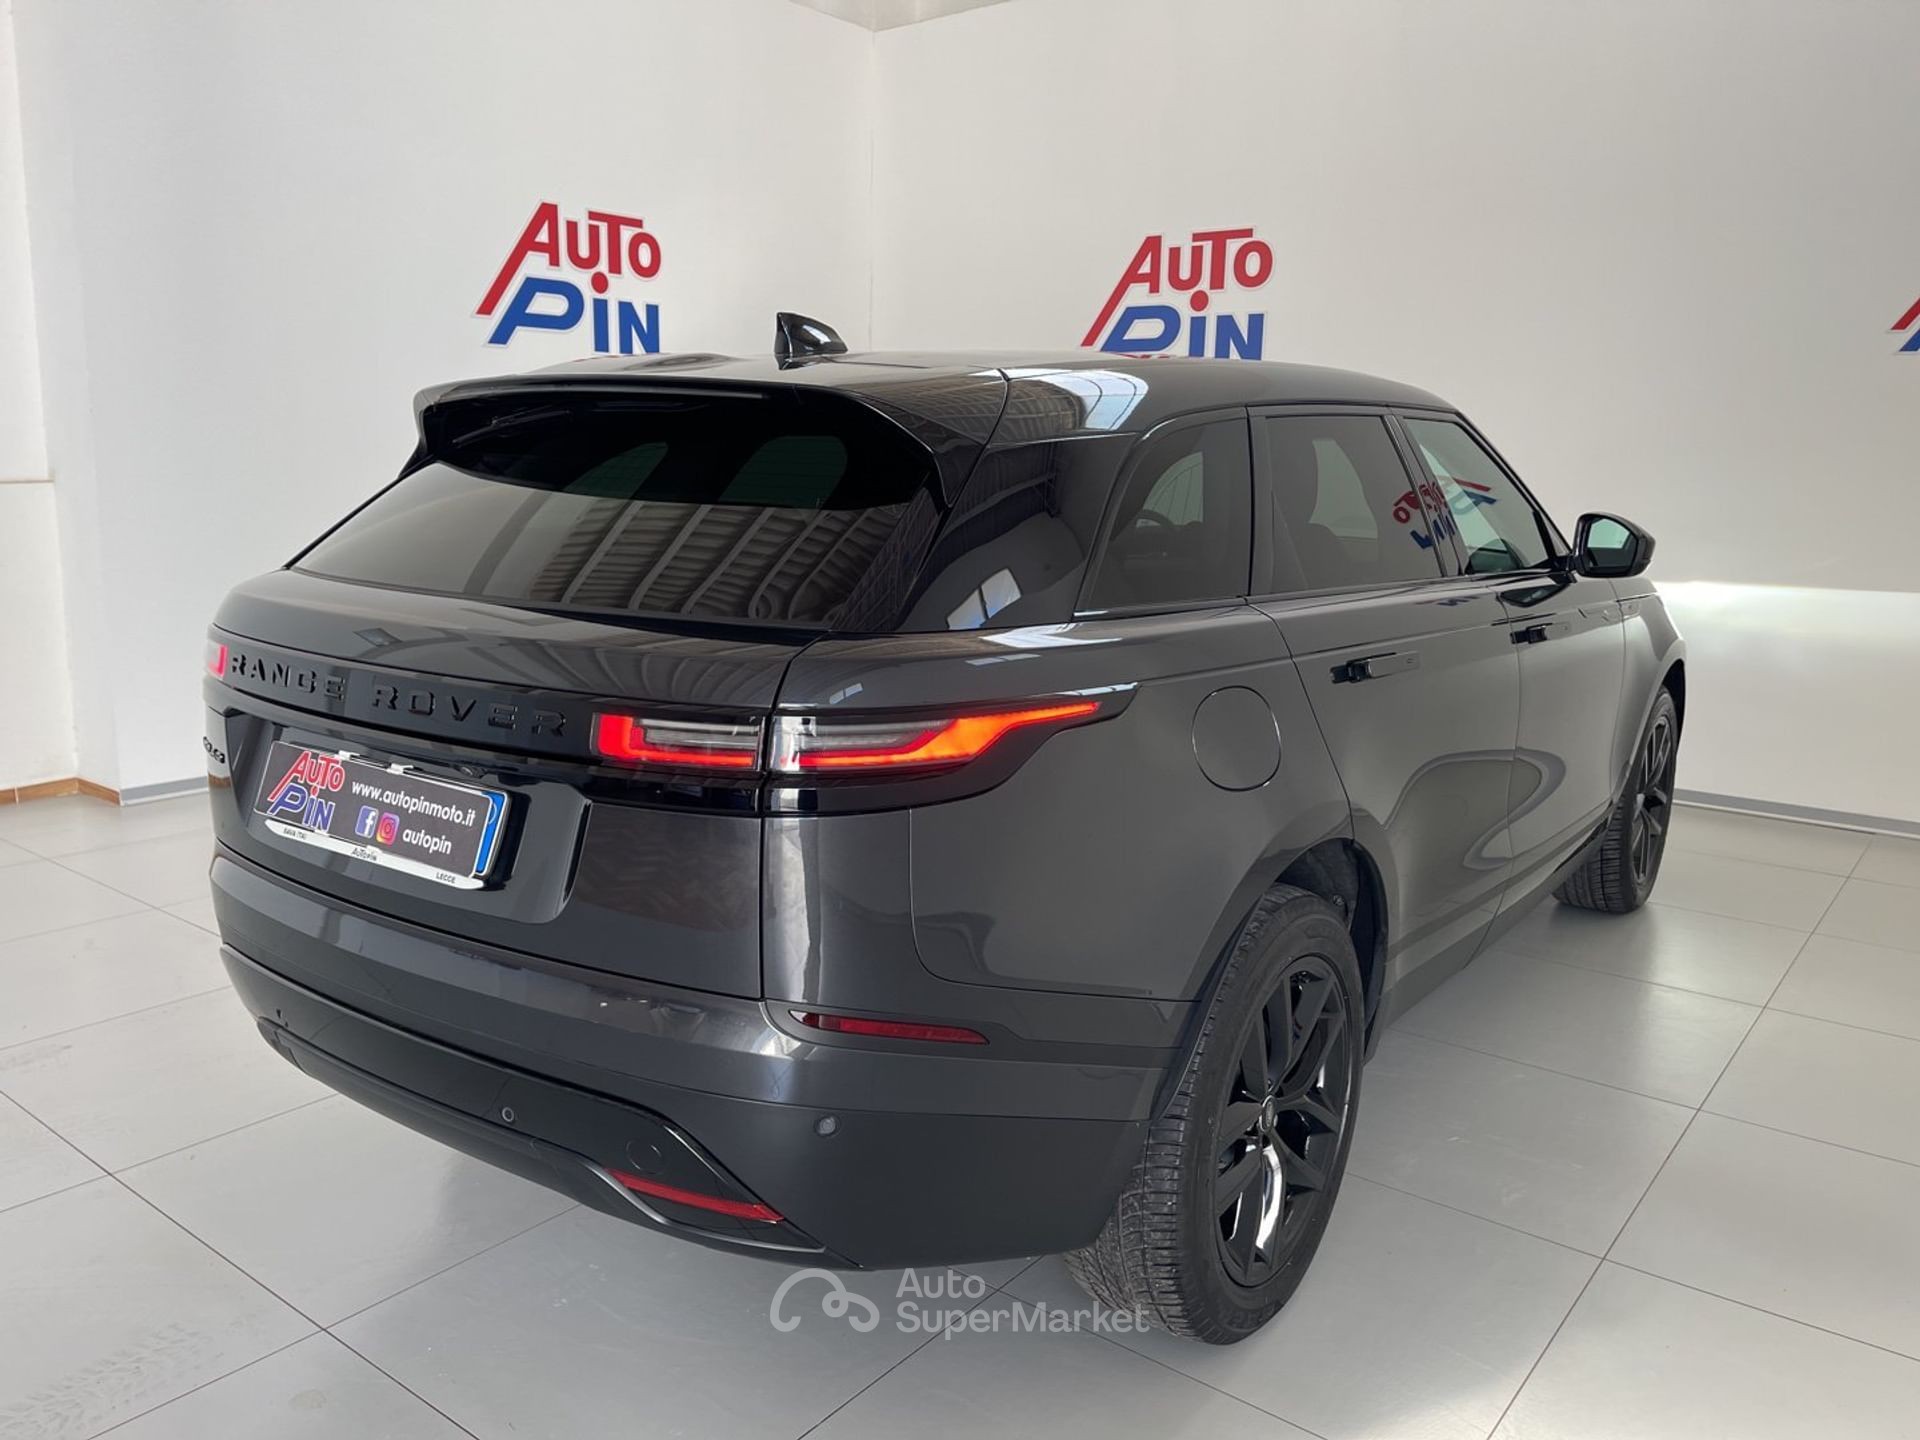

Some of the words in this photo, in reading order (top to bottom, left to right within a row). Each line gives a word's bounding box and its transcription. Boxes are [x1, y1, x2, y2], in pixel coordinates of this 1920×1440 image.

[231, 653, 345, 701] RANGE
[371, 684, 567, 737] ROVER
[351, 780, 476, 828] www.autopinmoto.it
[402, 827, 453, 855] autopin
[435, 871, 457, 884] LECCE
